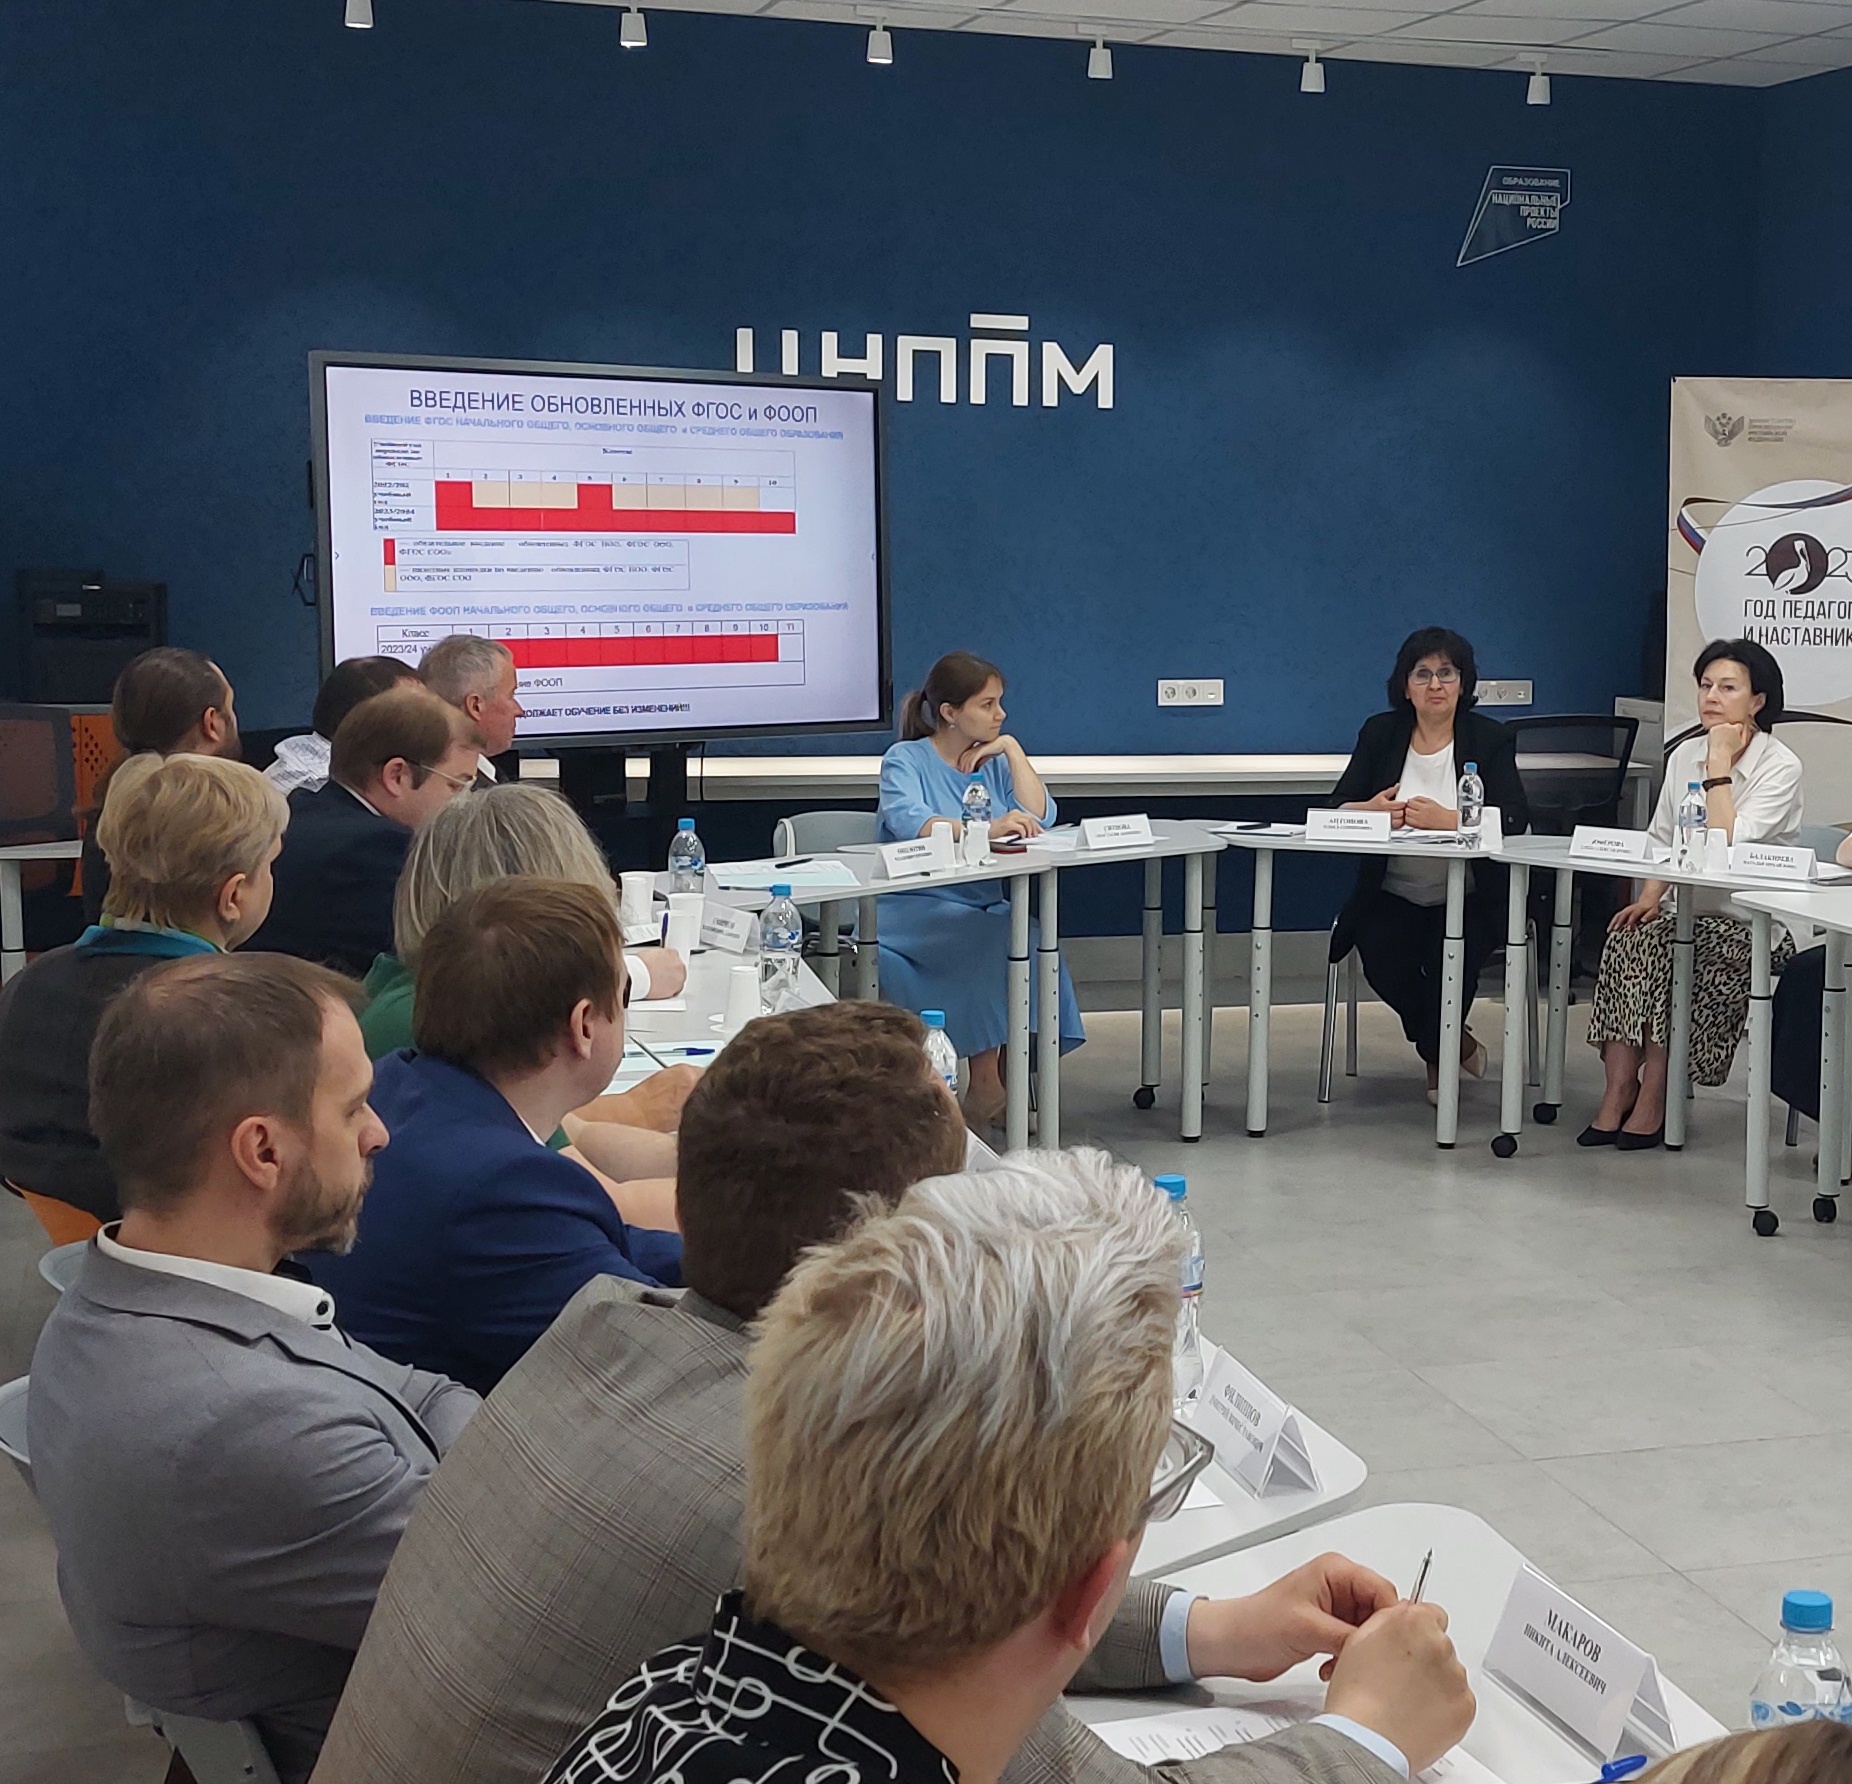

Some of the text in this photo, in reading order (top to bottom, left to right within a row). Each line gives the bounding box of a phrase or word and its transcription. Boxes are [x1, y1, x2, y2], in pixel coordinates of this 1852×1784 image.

[1502, 176, 1560, 187] ОБРАЗОВАНИЕ
[1492, 193, 1557, 206] НАЦИОНАЛЬНЫЕ
[1520, 205, 1558, 218] ПРОЕКТЫ
[1526, 217, 1557, 230] РОССИИ
[410, 389, 817, 424] ВВЕДЕНИЕ ОБНОВЛЕННЫХ ФГОС и ФООП
[365, 414, 421, 425] ВВЕДЕНИЕ
[424, 416, 452, 426] ФГОС
[456, 418, 523, 428] НАЧАЛЬНОГО
[527, 421, 571, 431] ОБЩЕГО,
[575, 422, 634, 432] ОСНОВНОГО
[637, 424, 677, 434] ОБЩЕГО
[690, 426, 737, 436] СРЕДНЕГО
[740, 428, 777, 438] ОБЩЕГО
[370, 606, 426, 617] ВВЕДЕНИЕ
[429, 606, 460, 616] ФООП
[463, 605, 531, 615] НАЧАЛЬНОГО
[533, 604, 578, 615] ОБЩЕГО,
[581, 604, 640, 613] ОСНОВНОГО
[643, 603, 683, 613] ОБЩЕГО
[696, 603, 742, 613] СРЕДНЕГО
[745, 602, 783, 612] ОБЩЕГО
[1743, 599, 1777, 621] ГОД
[401, 629, 430, 638] Класс
[505, 627, 512, 635] 2
[544, 626, 550, 635] 3
[580, 626, 586, 635] 4
[614, 625, 620, 634] 5
[645, 625, 652, 633] 6
[675, 624, 681, 633] 7
[704, 624, 710, 632] 8
[732, 623, 739, 632] 9
[759, 623, 769, 632] 10
[1743, 625, 1756, 647] И
[381, 645, 418, 654] 2023/24
[533, 678, 563, 687] ФООП
[1545, 1608, 1603, 1664] МАКАРОВ
[1523, 1622, 1608, 1696] НИКИТА АЛЕКСЕЕВИЧ
